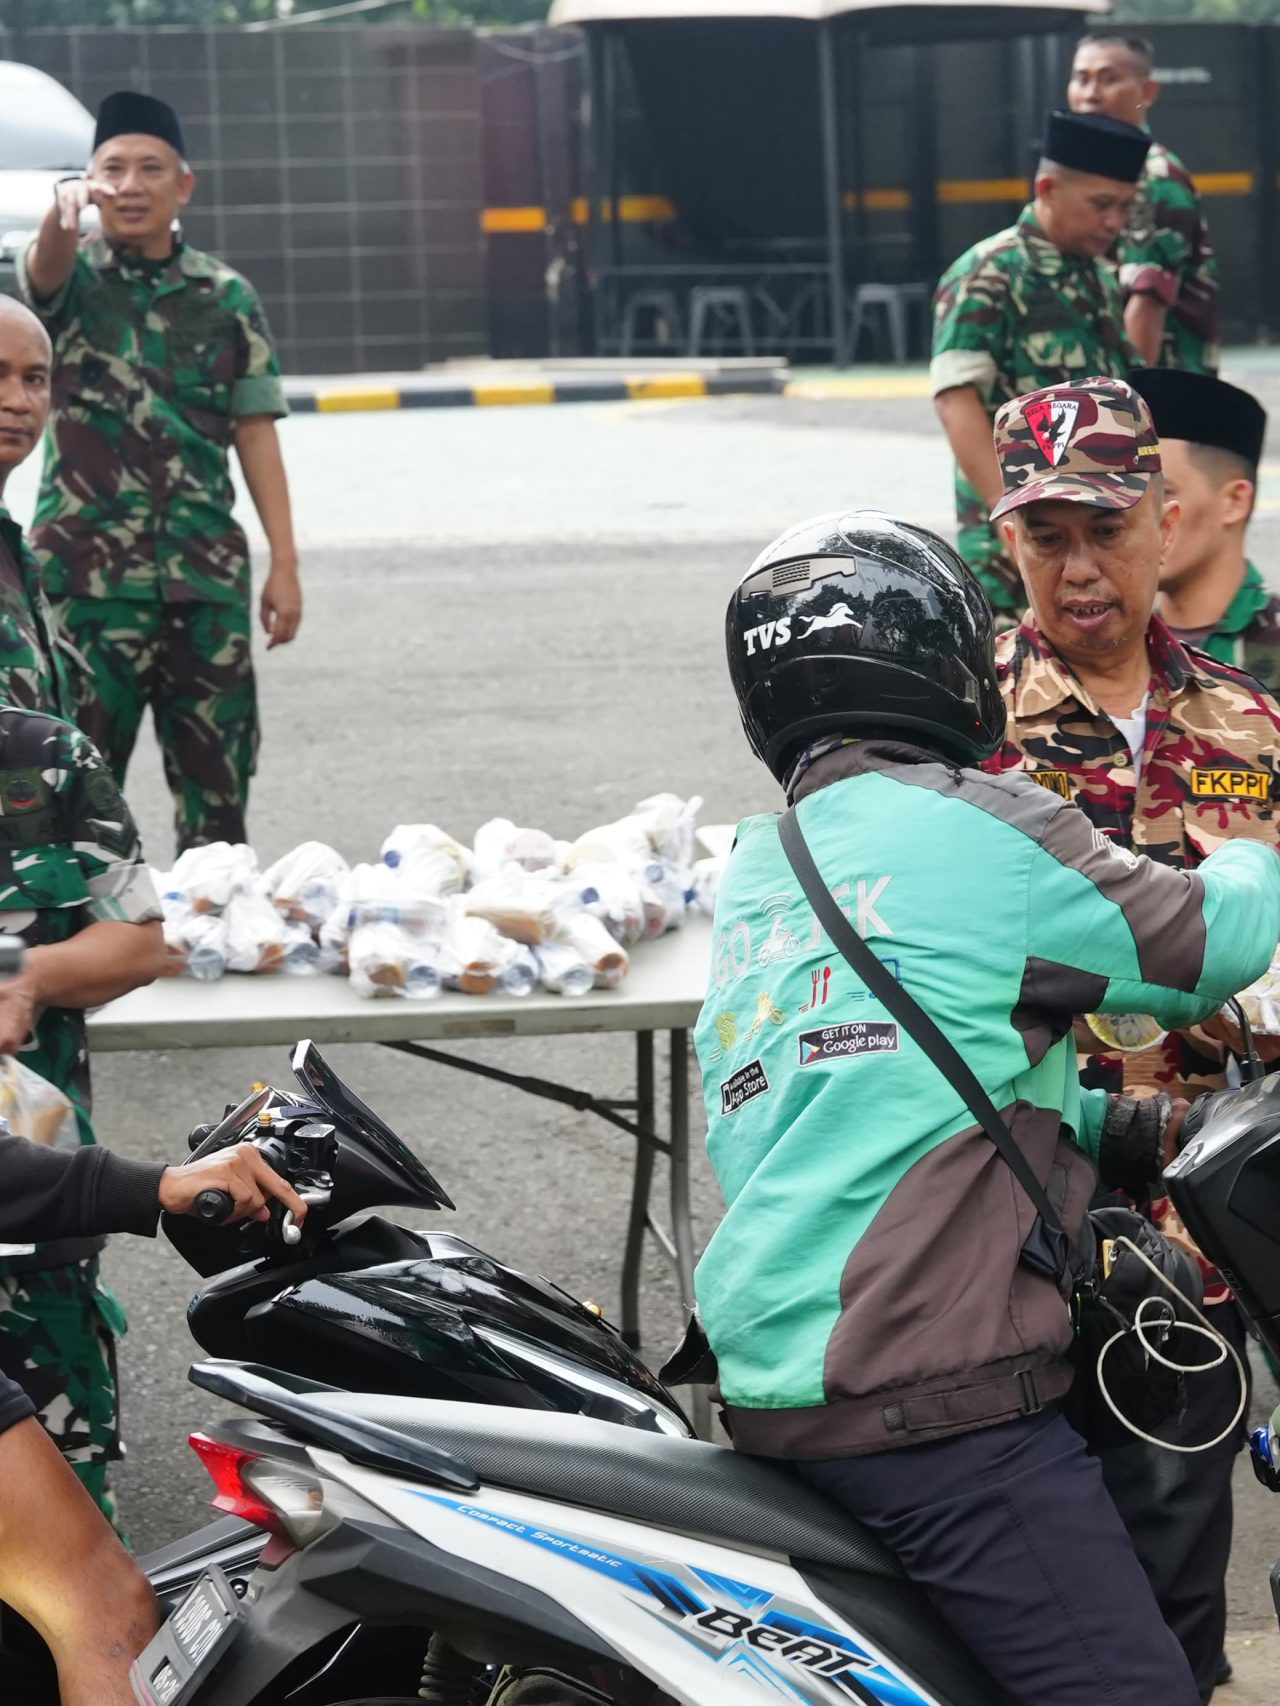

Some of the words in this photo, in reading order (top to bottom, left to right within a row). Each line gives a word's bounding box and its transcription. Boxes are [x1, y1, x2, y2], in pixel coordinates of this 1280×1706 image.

[743, 616, 792, 656] TVS
[1195, 771, 1265, 797] FKPPI
[713, 920, 751, 989] GO
[821, 1026, 840, 1040] GET
[841, 1026, 850, 1037] IT
[851, 1023, 867, 1035] ON
[822, 1035, 867, 1053] Google
[868, 1033, 896, 1049] play
[731, 1089, 744, 1107] App
[743, 1075, 767, 1096] Store
[456, 1505, 525, 1534] Compact
[531, 1530, 623, 1568] Sportmatic
